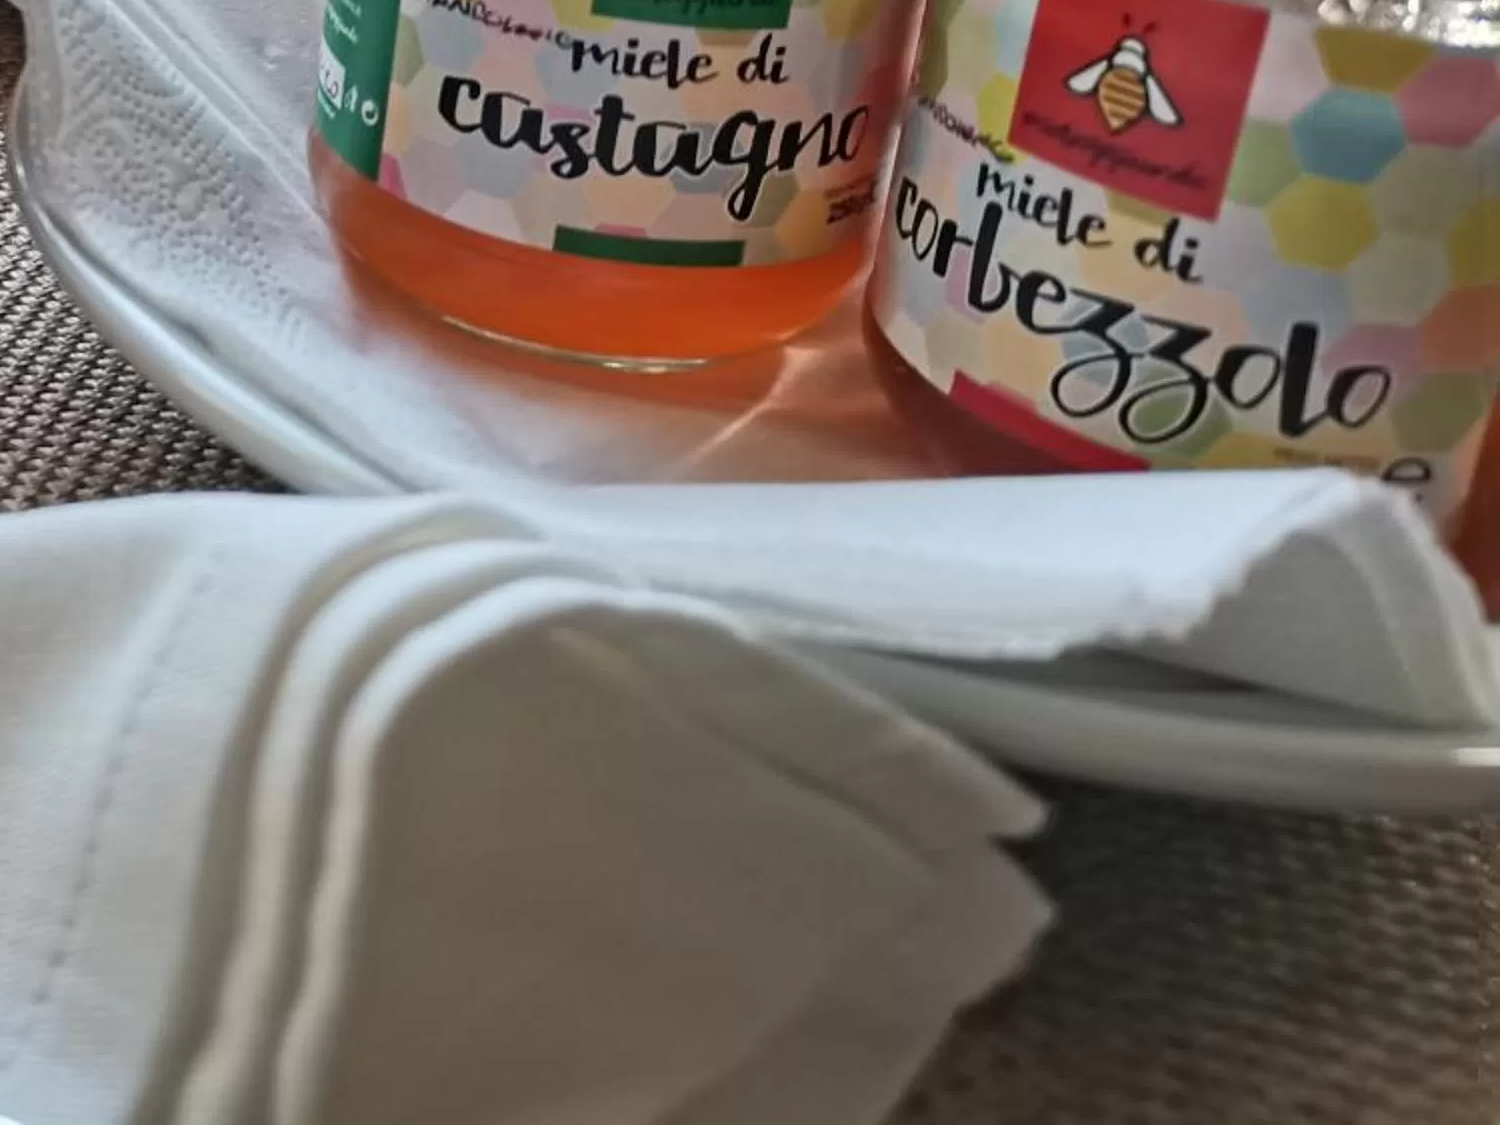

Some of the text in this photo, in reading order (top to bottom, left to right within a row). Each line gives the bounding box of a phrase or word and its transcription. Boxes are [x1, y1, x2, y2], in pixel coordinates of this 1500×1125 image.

[571, 32, 791, 88] miele di
[437, 75, 869, 221] castagno
[976, 161, 1204, 285] miele di
[895, 177, 1392, 446] corbezzolo
